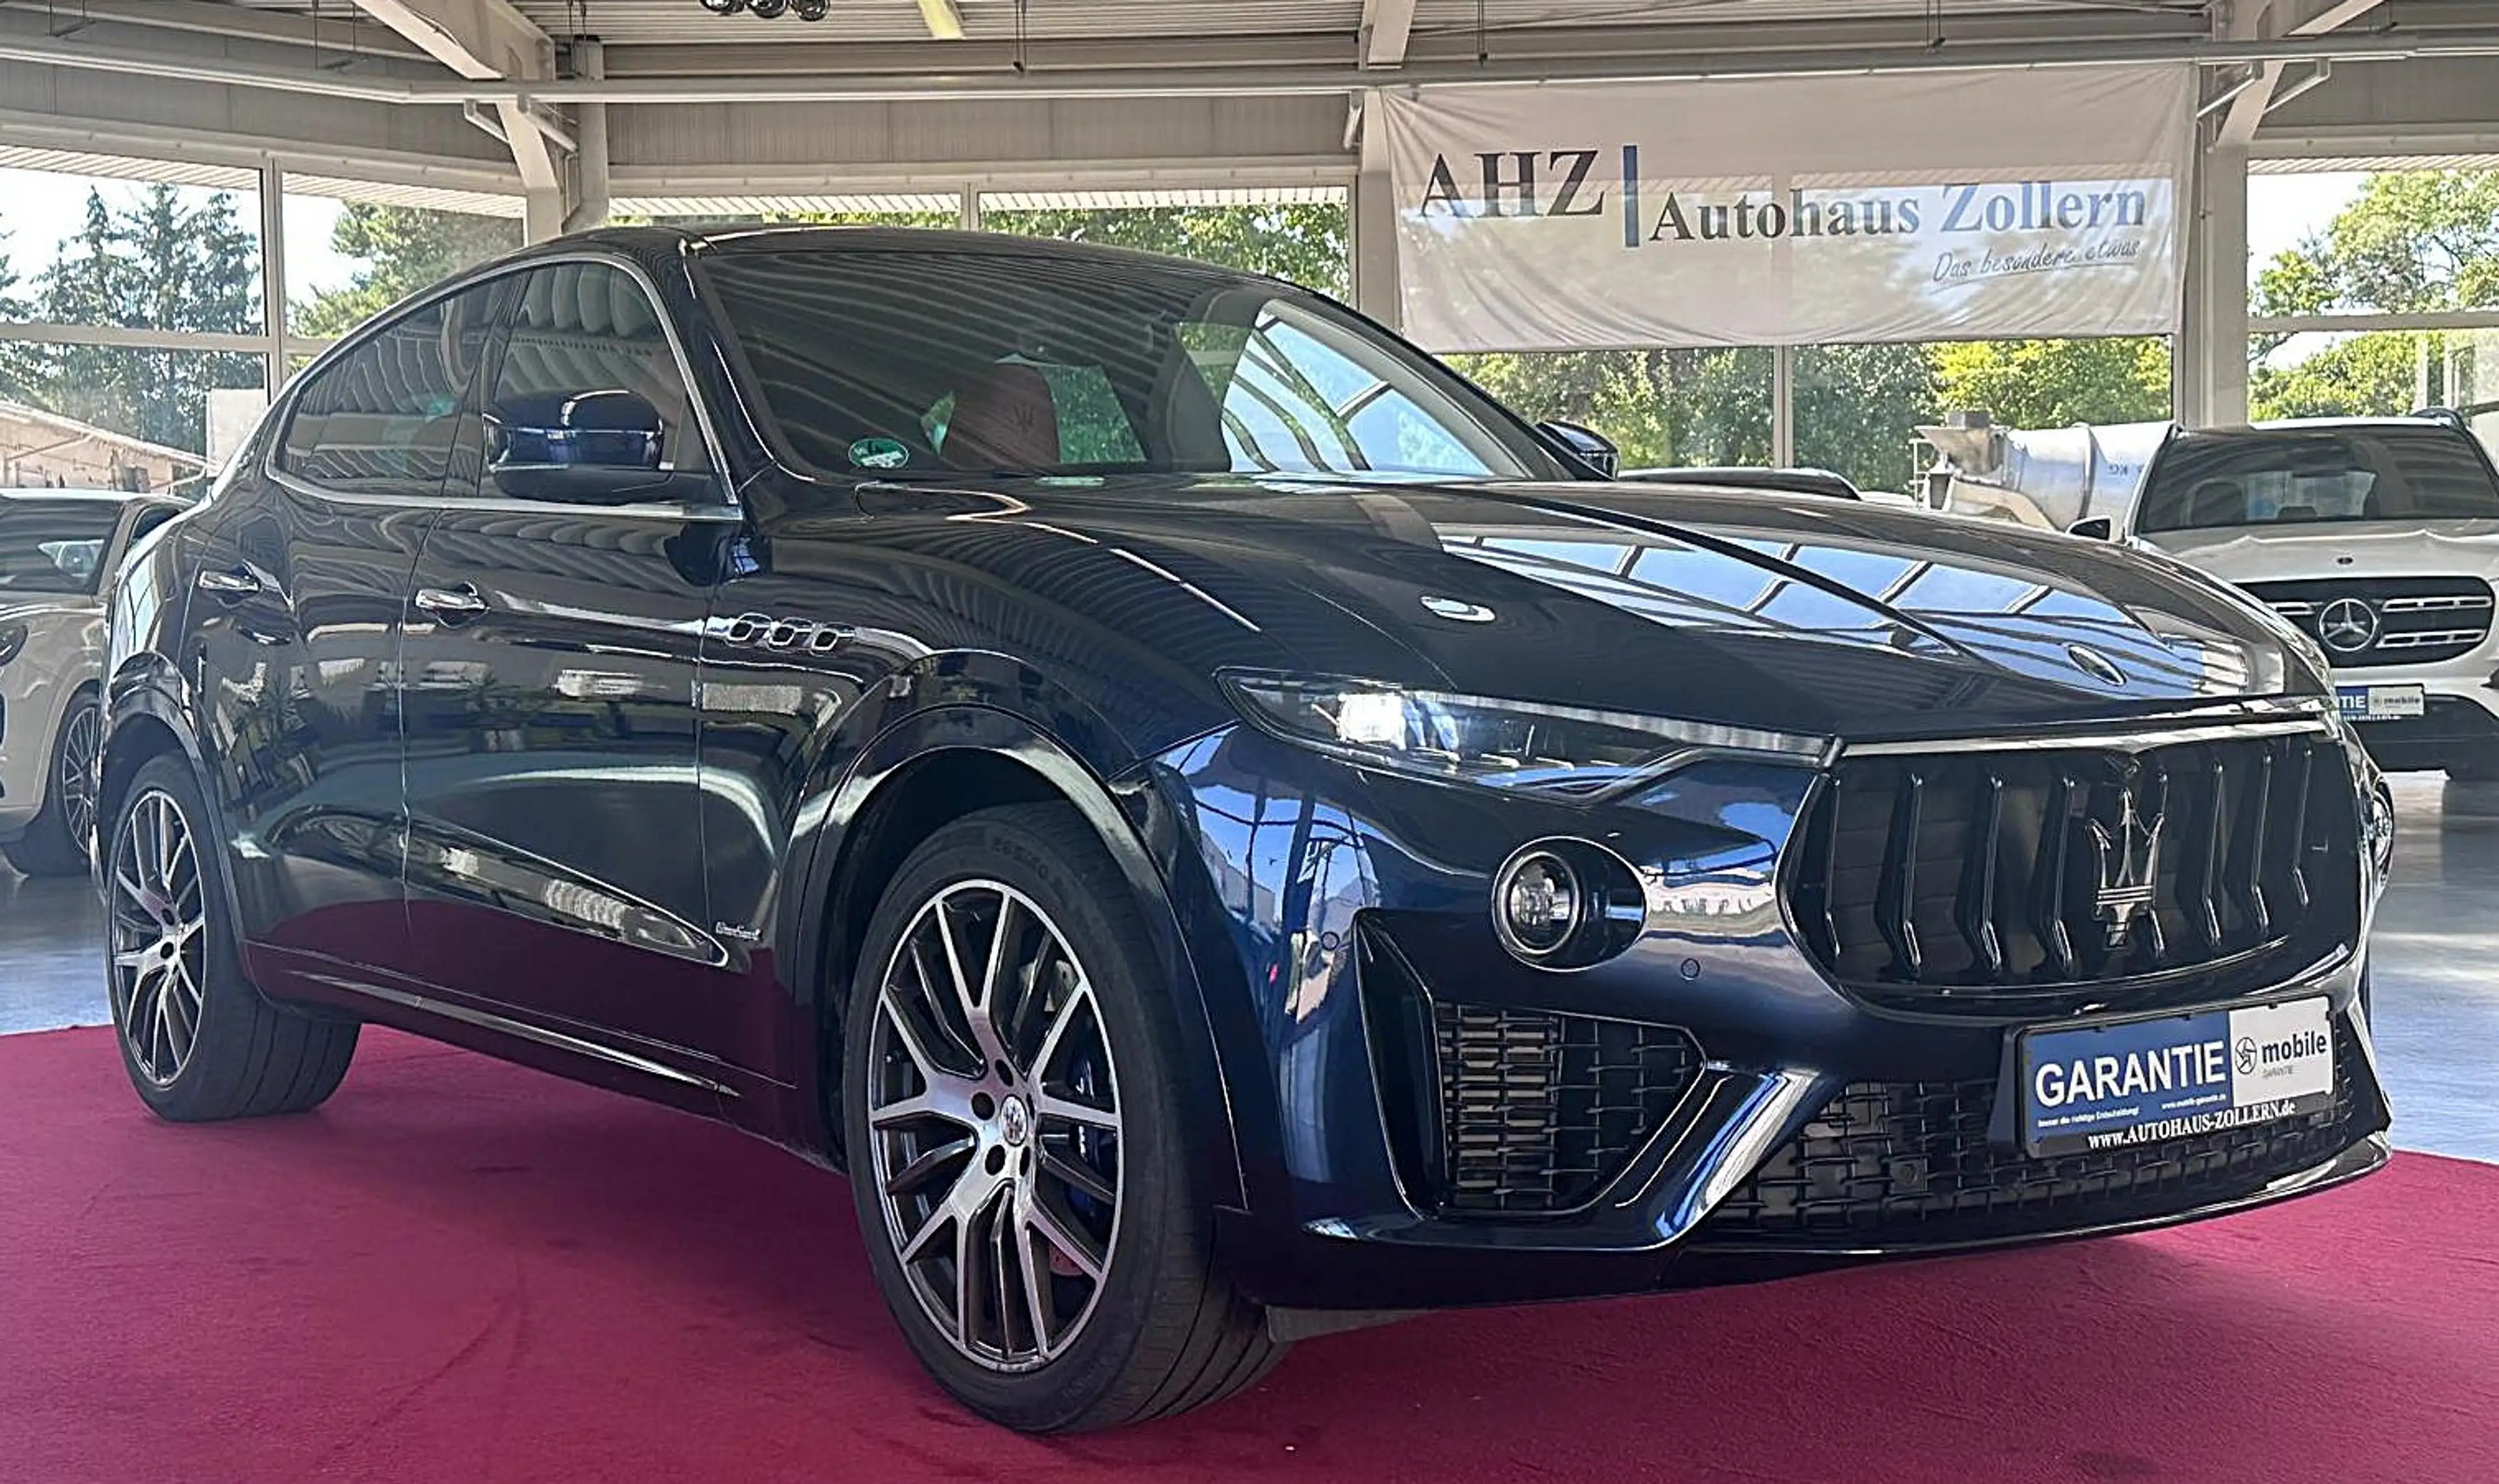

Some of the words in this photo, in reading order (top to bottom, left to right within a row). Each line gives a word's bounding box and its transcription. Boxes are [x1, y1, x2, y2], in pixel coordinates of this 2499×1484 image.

[1419, 150, 1604, 218] AHZ
[1648, 188, 1920, 242] Autohaus
[1940, 180, 2145, 232] Zollern
[1933, 252, 1972, 282] Das
[1979, 242, 2075, 272] besondere
[2084, 239, 2140, 260] etwas
[2035, 1041, 2226, 1107] GARANTIE
[2261, 1031, 2327, 1064] mobile
[2088, 1100, 2296, 1150] www.AUTOHAUS-ZOLLERN.de
